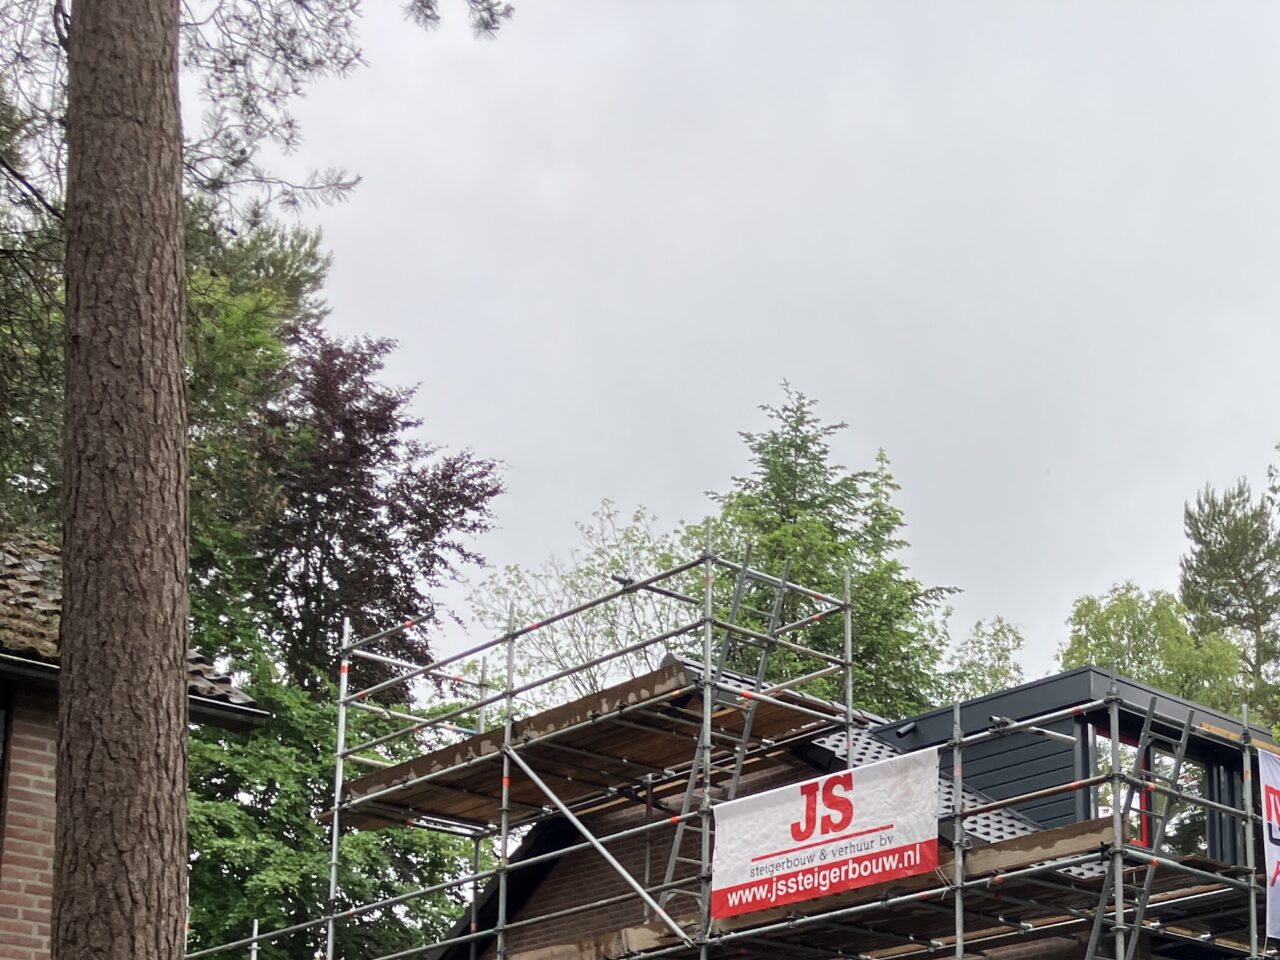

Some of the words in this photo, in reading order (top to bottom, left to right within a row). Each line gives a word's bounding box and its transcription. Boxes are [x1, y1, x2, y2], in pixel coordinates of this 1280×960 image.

[790, 771, 854, 842] JS
[727, 843, 921, 907] www.jssteigerbouw.nl
[750, 854, 816, 878] steigerbouw
[819, 848, 828, 860] &
[832, 840, 876, 858] verhuur
[879, 834, 894, 847] bv
